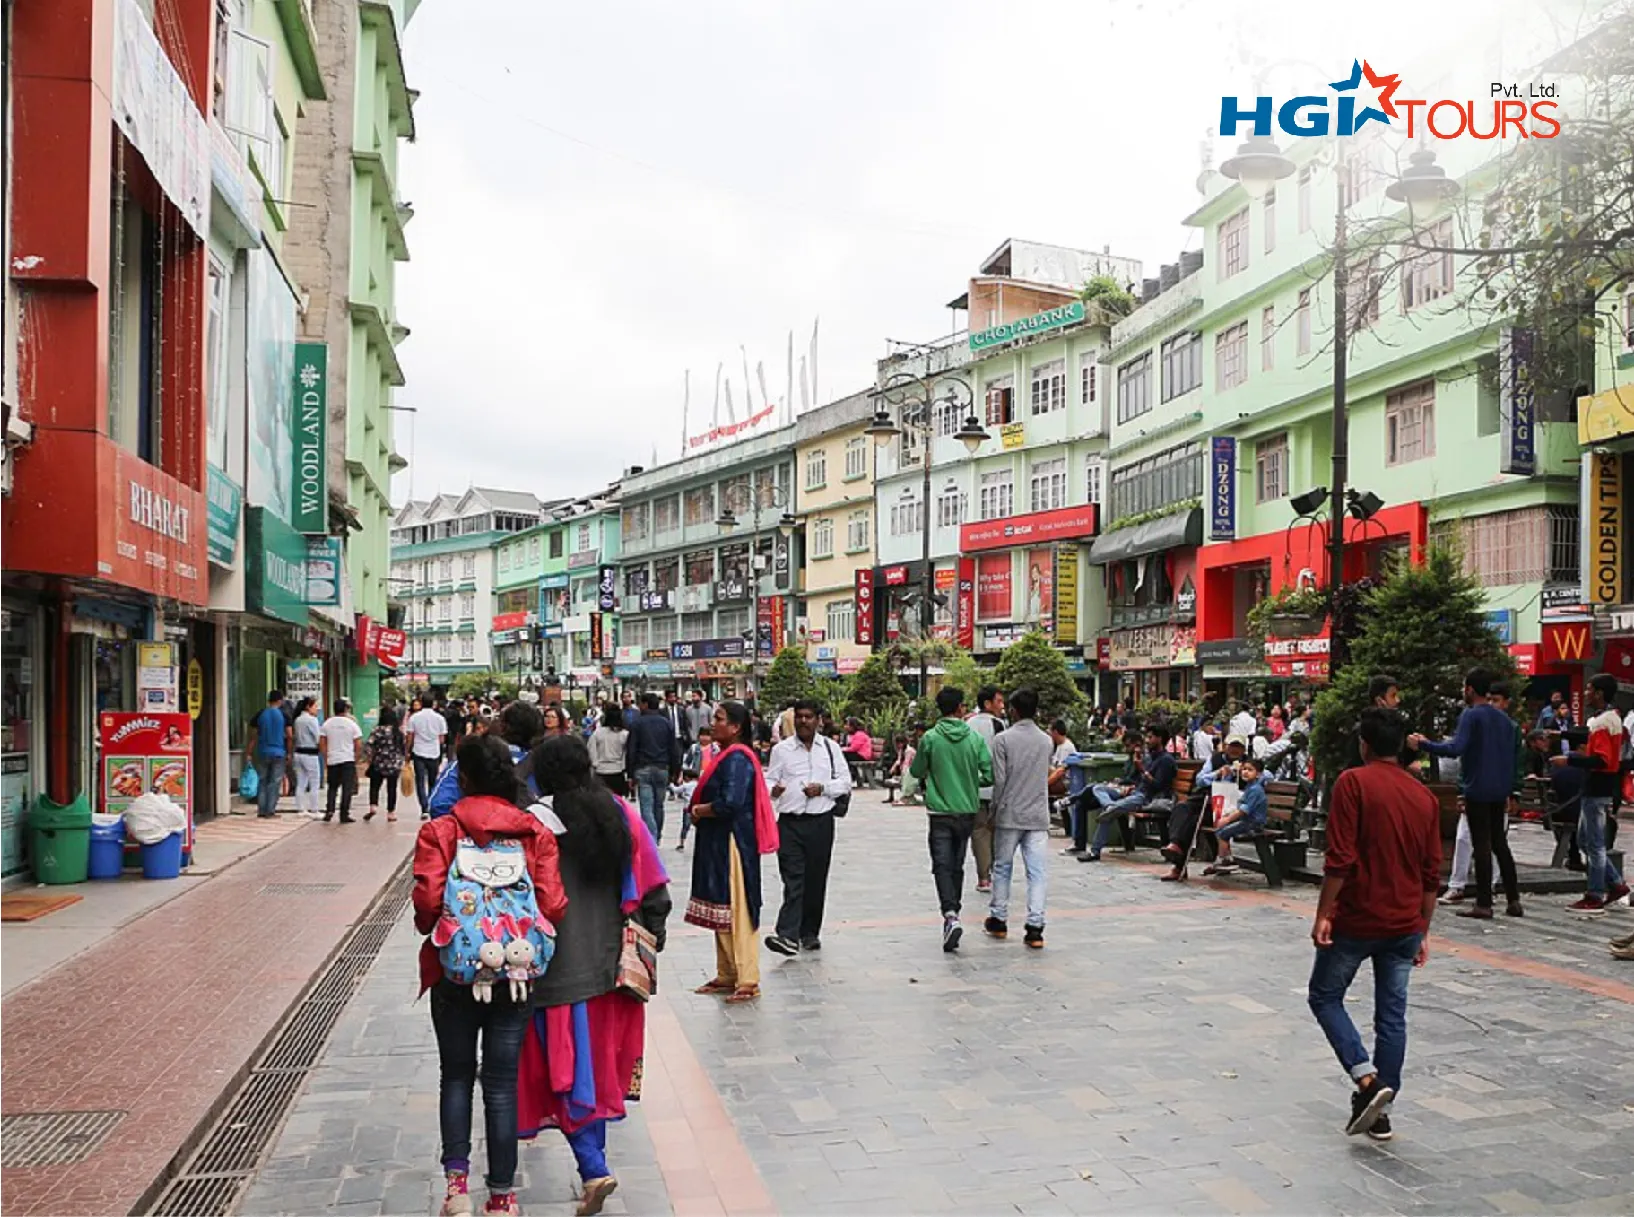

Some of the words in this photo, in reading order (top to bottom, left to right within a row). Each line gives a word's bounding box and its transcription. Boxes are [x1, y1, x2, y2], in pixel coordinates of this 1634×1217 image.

[301, 391, 321, 516] WOODLAND
[1217, 463, 1230, 517] DZONG
[129, 480, 188, 544] BHARAT
[1599, 506, 1617, 602] GOLDEN
